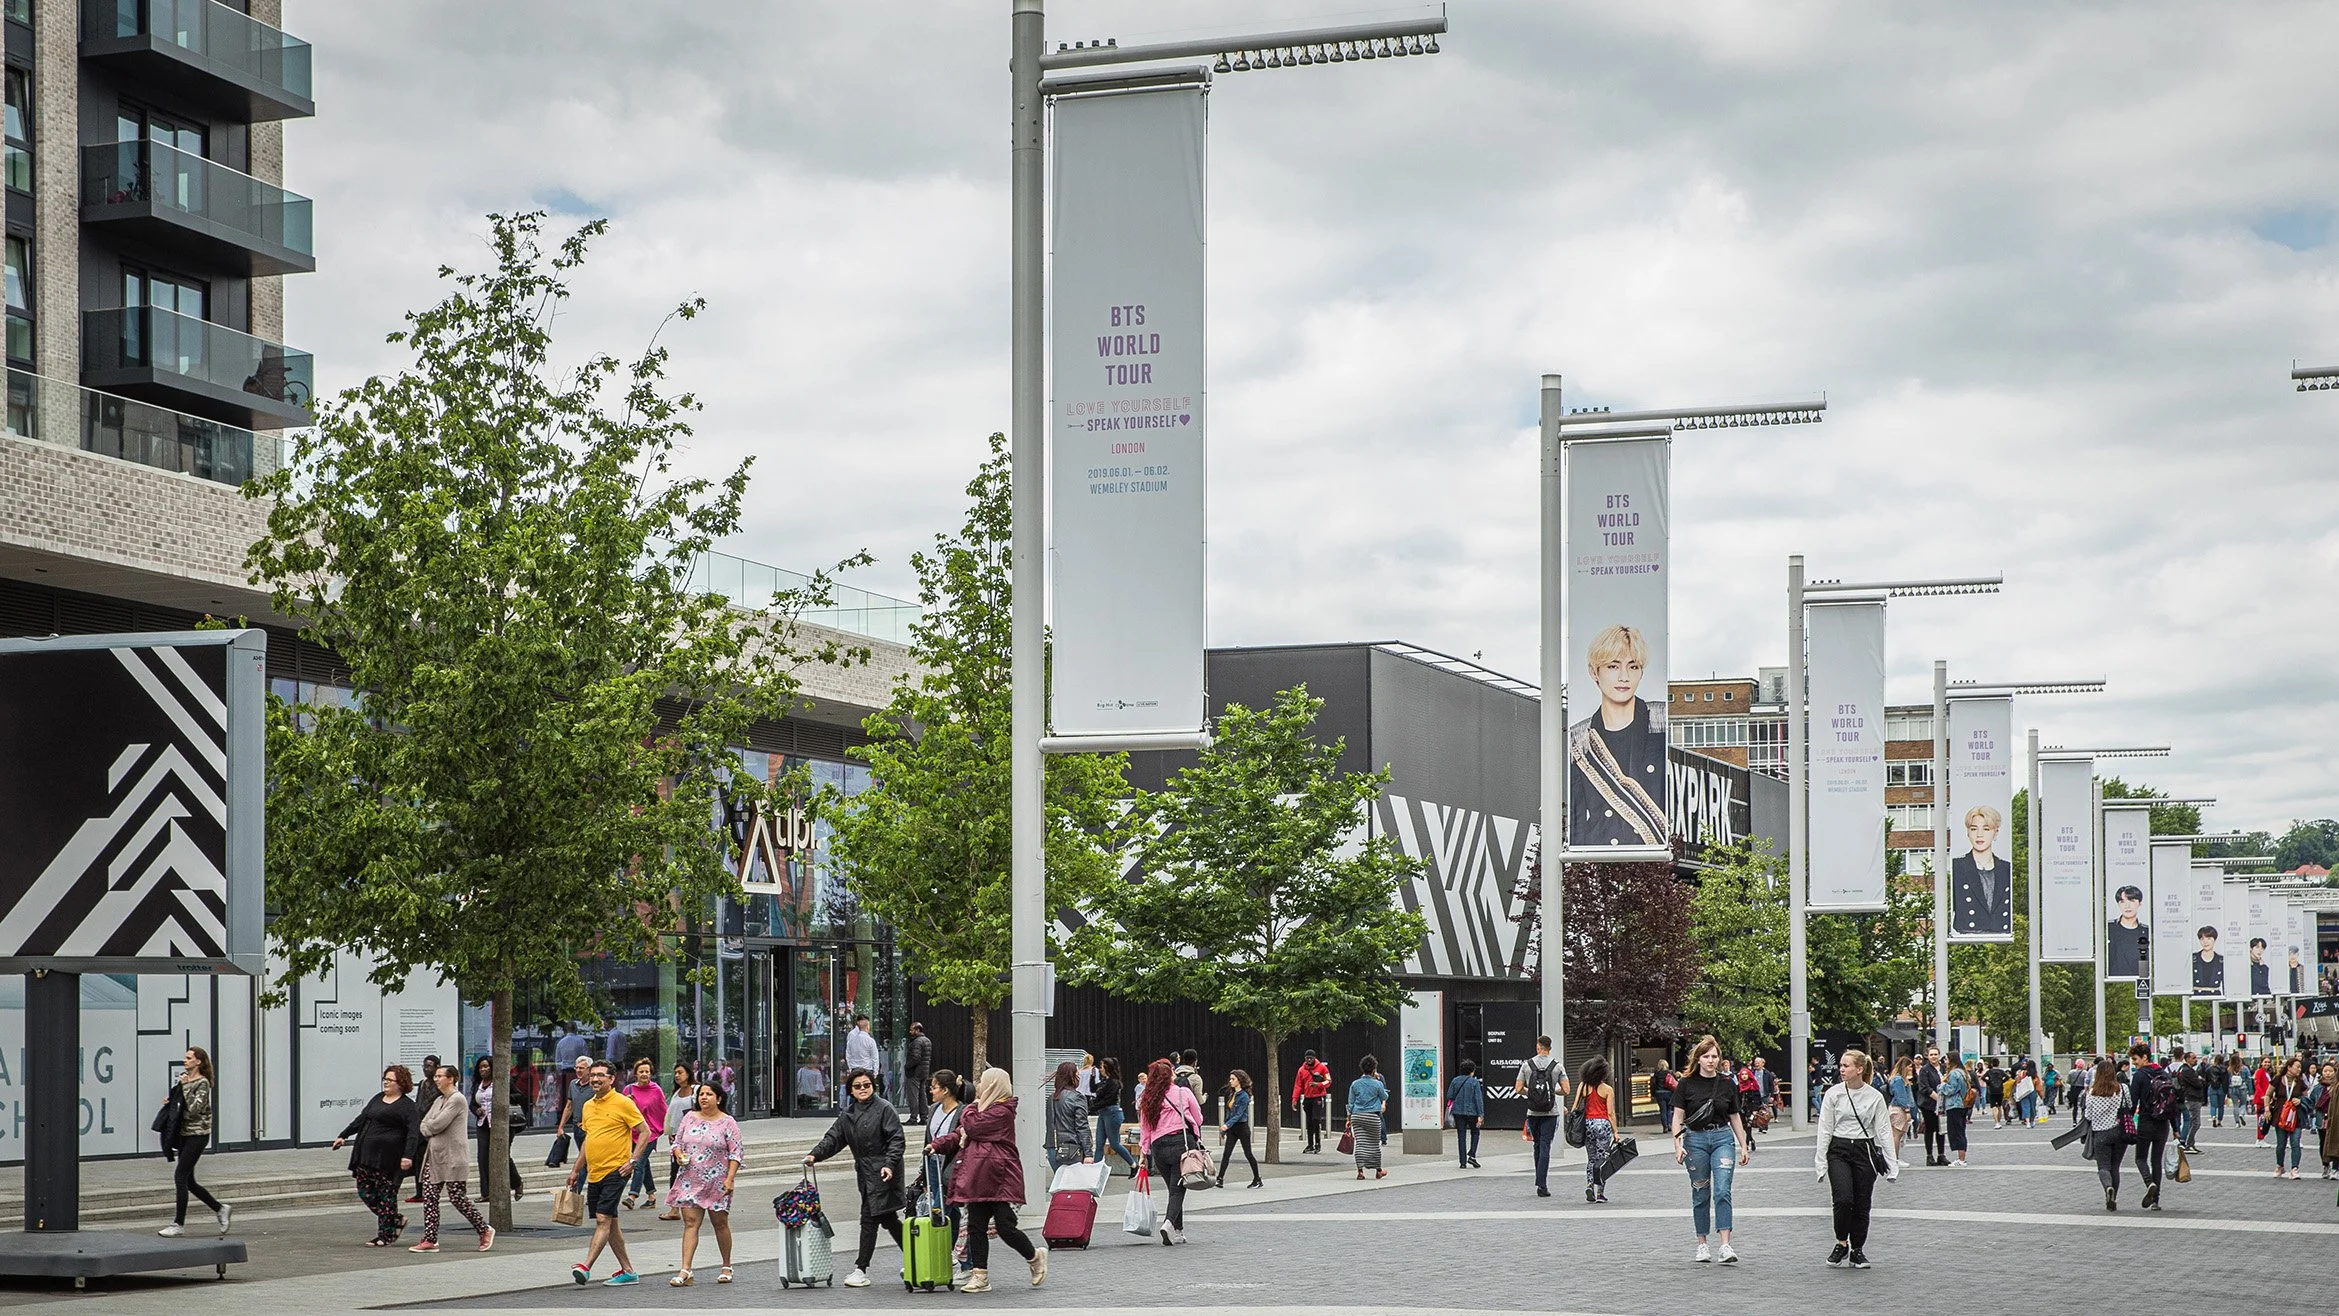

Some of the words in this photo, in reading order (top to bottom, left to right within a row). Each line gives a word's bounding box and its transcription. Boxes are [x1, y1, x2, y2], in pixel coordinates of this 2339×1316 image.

[1111, 304, 1145, 327] BTS
[1097, 333, 1160, 358] WORLD
[1104, 364, 1152, 386] TOUR
[1066, 401, 1105, 416] LOVE
[1111, 397, 1191, 412] YOURSELF
[1087, 416, 1120, 432] SPEAK
[1124, 414, 1177, 430] YOURSELF
[1111, 442, 1145, 454] LONDON
[1090, 482, 1128, 494] WEMBLEY
[1130, 480, 1168, 492] STADIUM
[1606, 494, 1630, 508] BTS
[1597, 512, 1640, 528] WORLD
[1603, 532, 1634, 546] TOUR
[1590, 566, 1614, 575] SPEAK
[1615, 565, 1651, 575] YOURSELF
[1838, 704, 1856, 714] BTS
[1831, 718, 1864, 728] WORLD
[1836, 731, 1860, 742] TOUR
[1973, 730, 1988, 738] BTS
[1968, 741, 1994, 750] WORLD
[1972, 752, 1990, 760] TOUR
[320, 1010, 339, 1018] Iconic
[340, 1010, 362, 1020] images
[320, 1024, 343, 1035] coming
